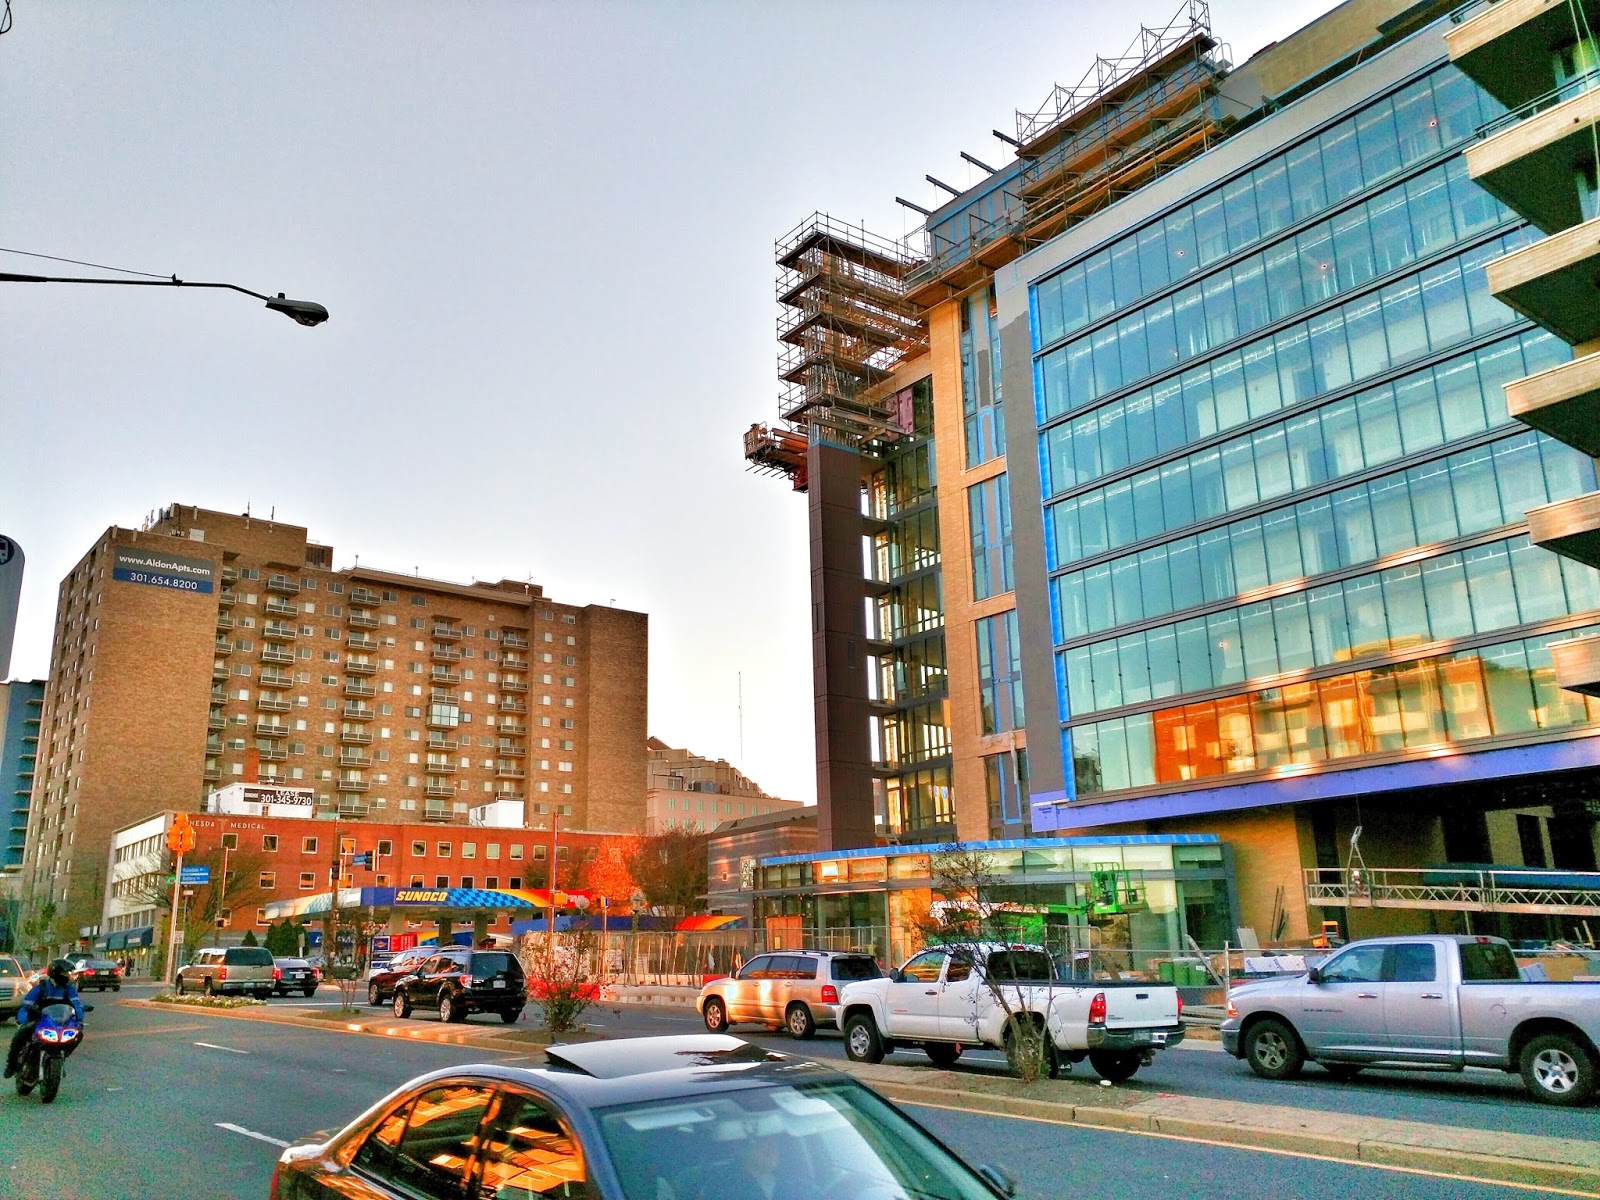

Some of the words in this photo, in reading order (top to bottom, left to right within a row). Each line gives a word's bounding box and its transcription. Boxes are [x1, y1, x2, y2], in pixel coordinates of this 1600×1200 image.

[119, 555, 211, 576] www.AldonApts.com
[130, 572, 198, 590] 301.654.8200
[260, 794, 312, 806] 301-345-9730
[230, 822, 266, 830] MEDICAL
[395, 890, 448, 902] SUNOCO
